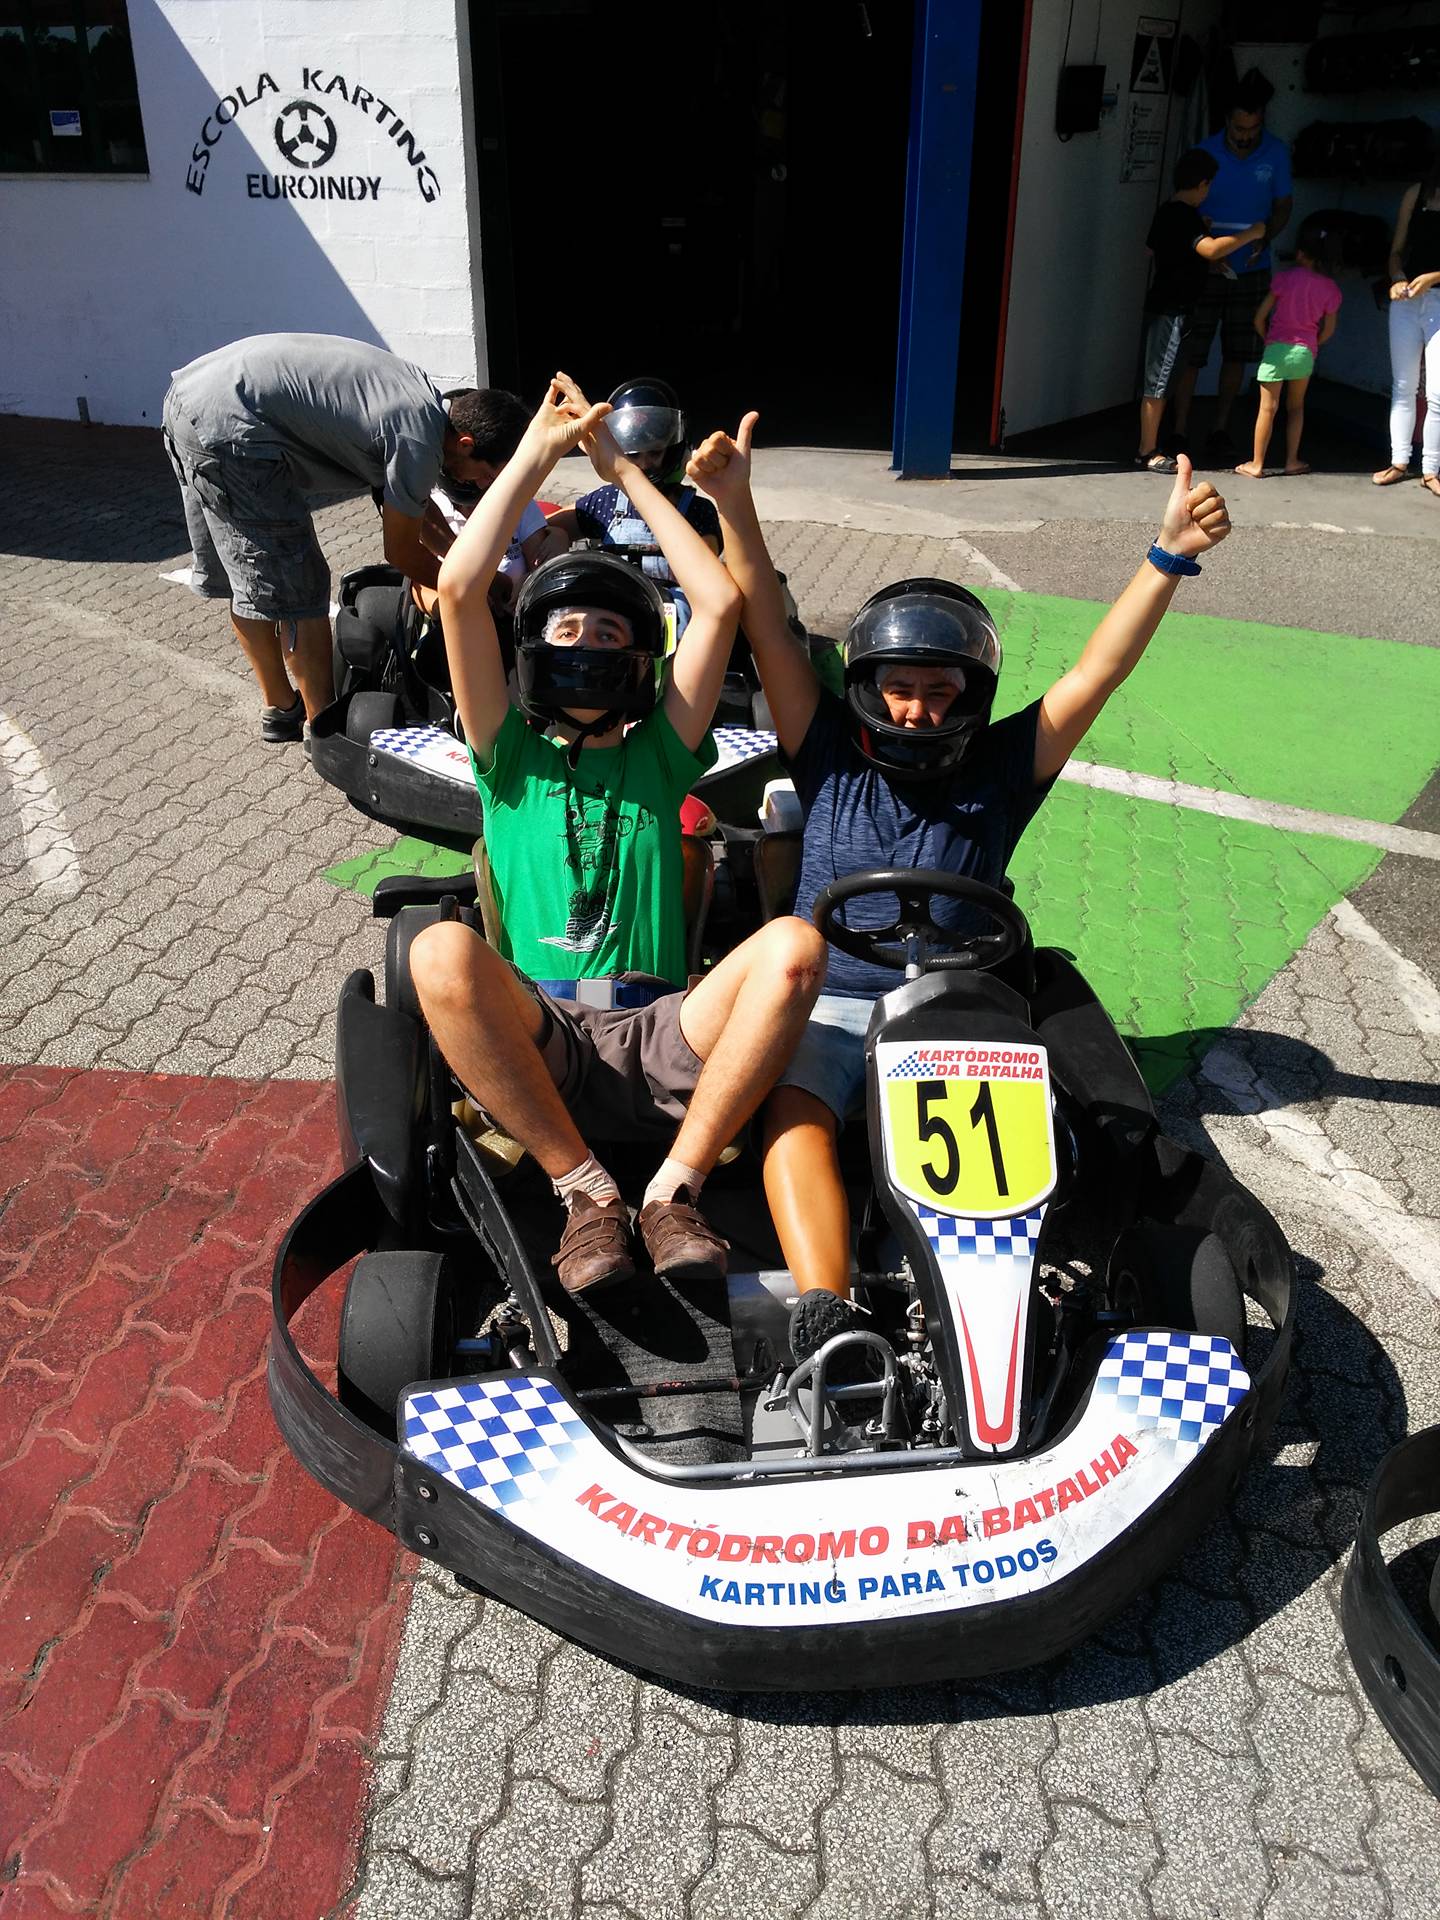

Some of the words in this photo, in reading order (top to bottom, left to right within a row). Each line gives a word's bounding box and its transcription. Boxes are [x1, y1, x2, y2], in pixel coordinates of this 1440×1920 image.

[185, 72, 281, 196] ESCOLA
[302, 67, 441, 203] KARTING
[246, 173, 382, 201] EUROINDY
[917, 1047, 1040, 1065] KARTÓDROMO
[935, 1064, 960, 1077] DA
[966, 1064, 1044, 1080] BATALHA
[916, 1080, 1009, 1196] 51
[575, 1483, 890, 1563] KARTÓDROMO
[906, 1515, 968, 1550] DA
[981, 1434, 1140, 1538] BATALHA
[699, 1574, 847, 1605] KARTING
[858, 1569, 946, 1601] PARA
[952, 1538, 1059, 1587] TODOS
